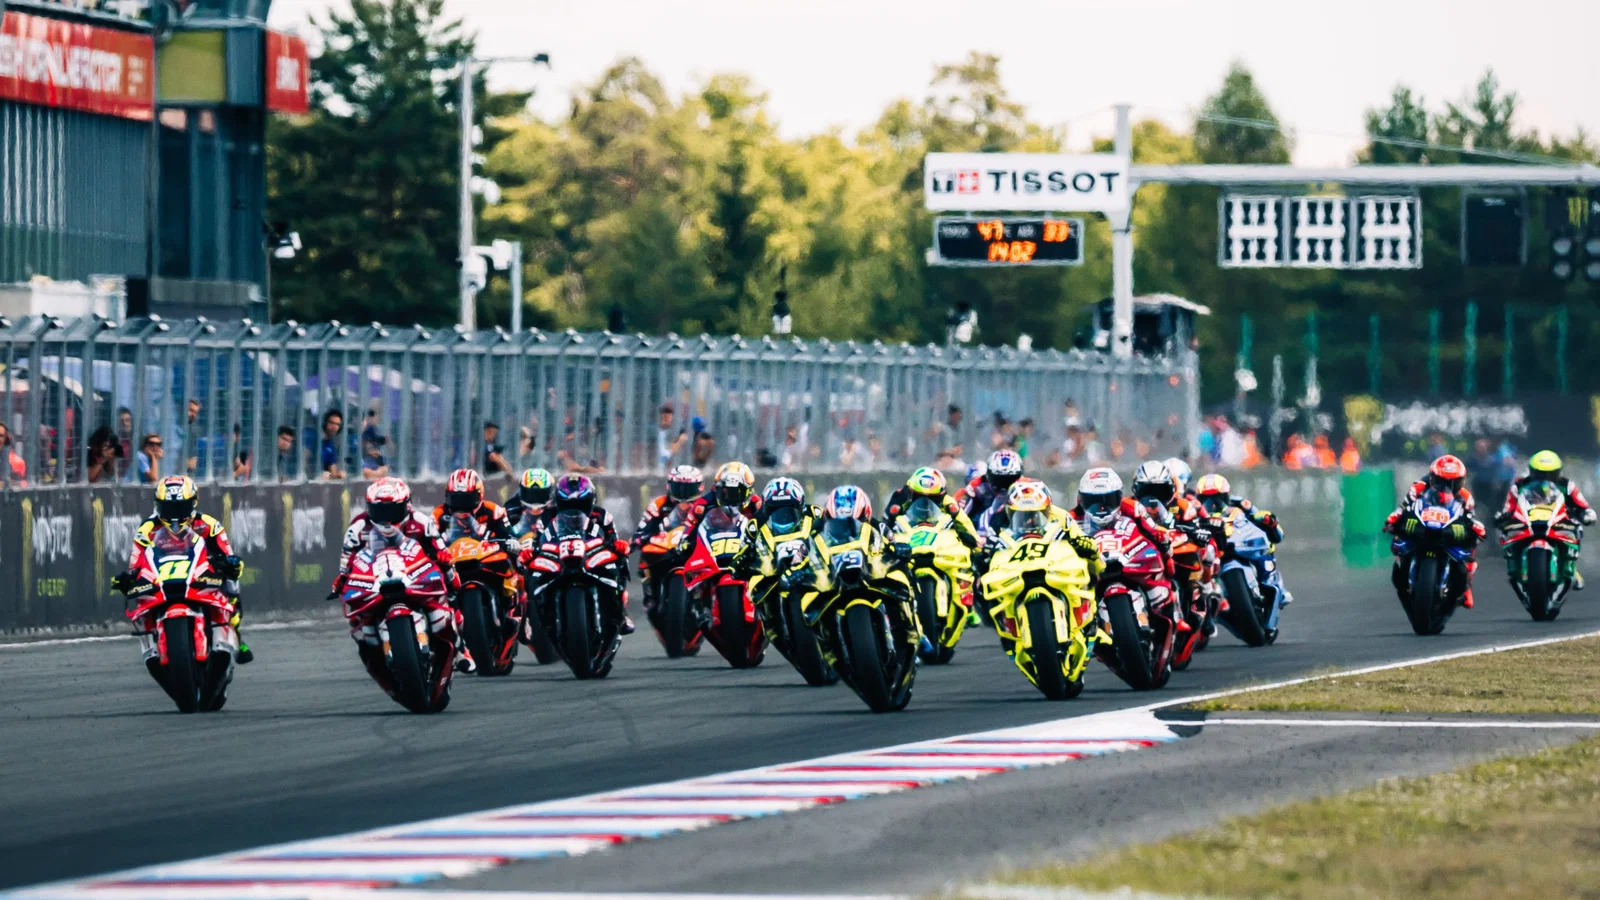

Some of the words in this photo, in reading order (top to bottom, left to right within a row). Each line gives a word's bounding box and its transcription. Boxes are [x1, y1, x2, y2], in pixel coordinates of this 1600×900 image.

[987, 170, 1120, 194] TISSOT
[710, 538, 741, 557] 36
[1008, 542, 1050, 563] 49
[155, 560, 191, 584] 11
[408, 562, 432, 580] Lenovo
[348, 580, 373, 588] Lenovo
